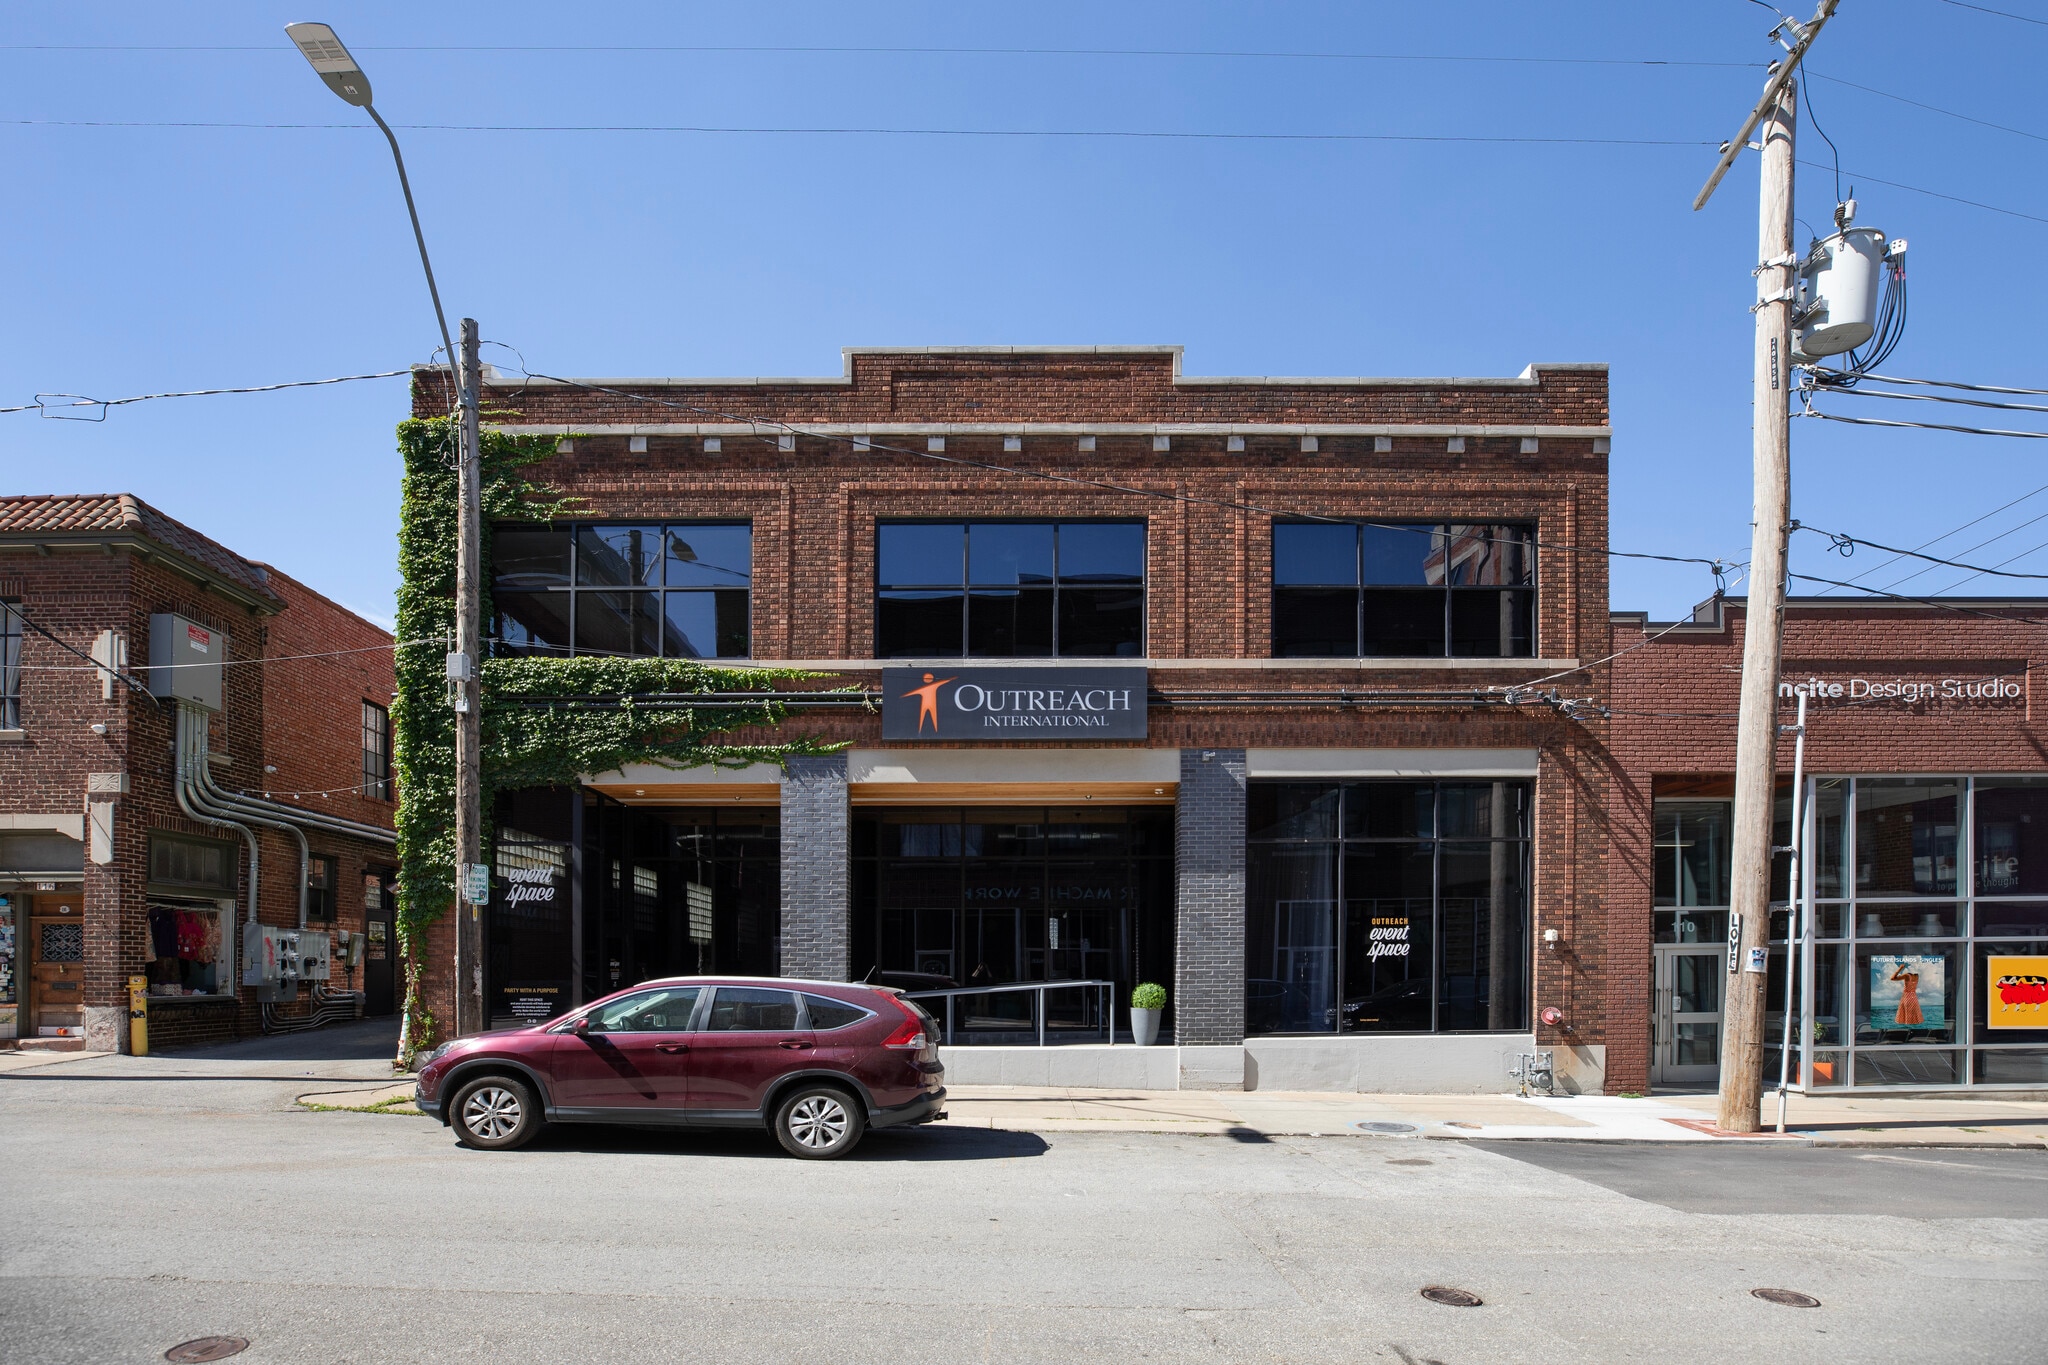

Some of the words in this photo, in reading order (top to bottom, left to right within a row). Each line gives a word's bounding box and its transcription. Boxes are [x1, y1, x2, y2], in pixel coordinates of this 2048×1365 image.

[954, 684, 1131, 712] OUTREACH
[1778, 677, 1844, 698] ncite
[1850, 679, 1935, 702] Design
[1941, 678, 2021, 698] Studio
[984, 715, 1109, 727] INTERNATIONAL
[508, 866, 554, 883] event
[1983, 876, 2019, 888] thought
[505, 884, 555, 908] space
[1370, 925, 1410, 940] event
[1671, 922, 1695, 932] 110
[1367, 941, 1410, 962] space
